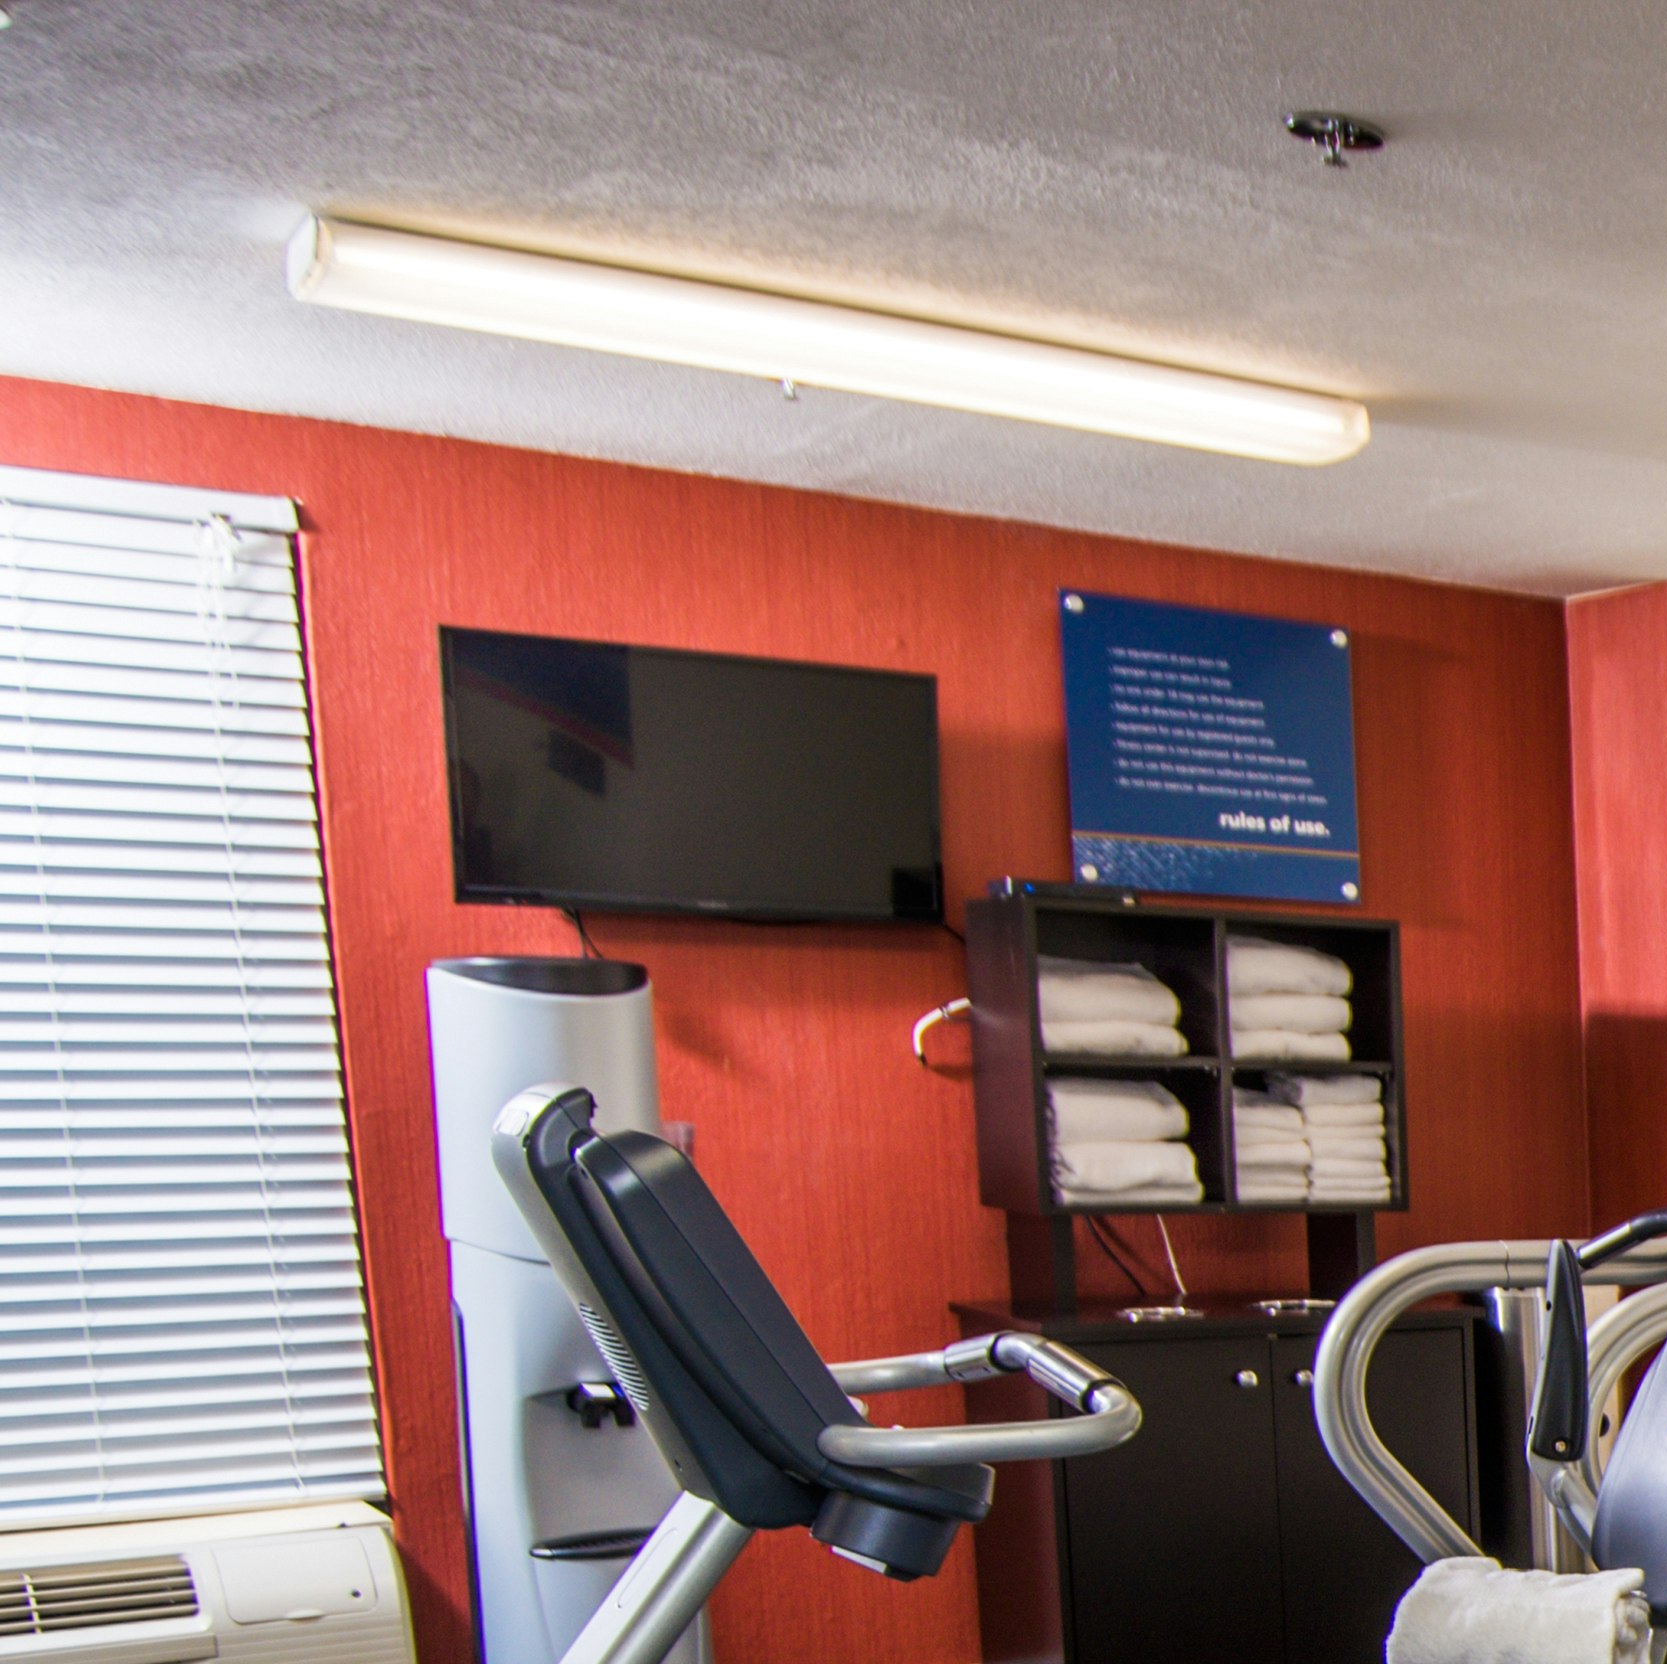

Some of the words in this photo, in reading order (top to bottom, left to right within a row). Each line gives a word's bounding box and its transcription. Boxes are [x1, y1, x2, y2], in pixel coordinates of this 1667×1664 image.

[1220, 811, 1266, 832] rules
[1269, 814, 1290, 833] of
[1294, 820, 1330, 836] use.
